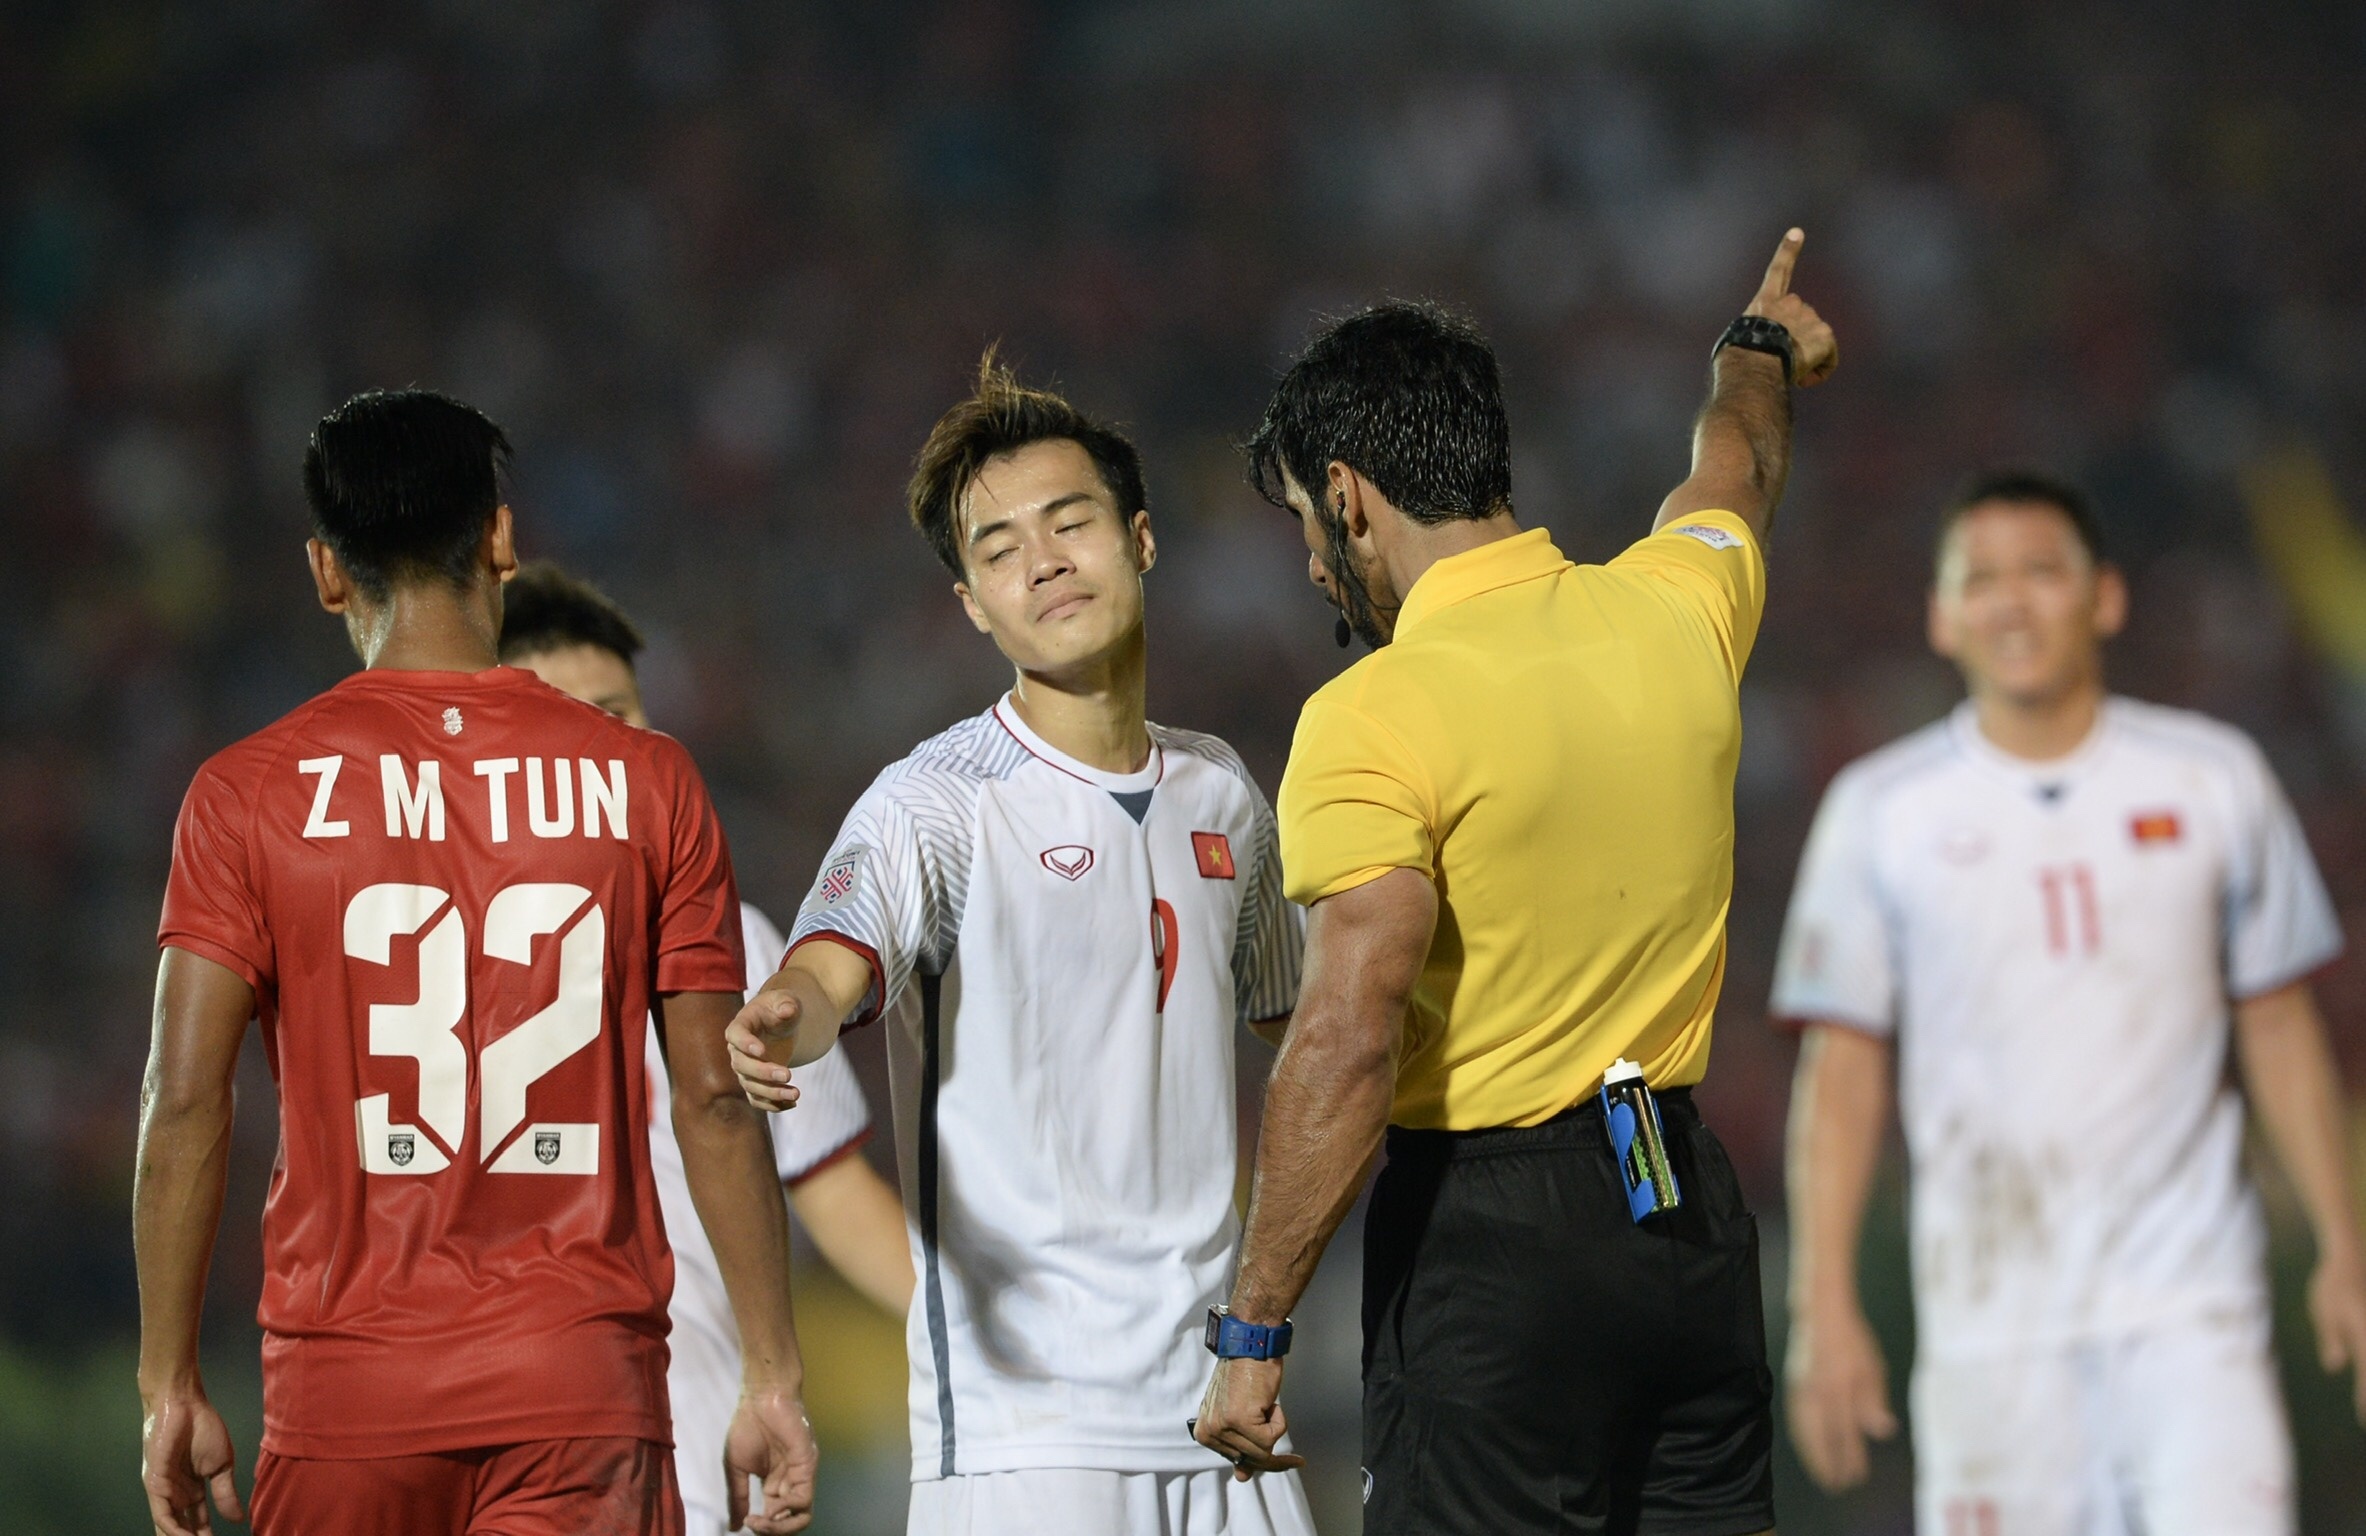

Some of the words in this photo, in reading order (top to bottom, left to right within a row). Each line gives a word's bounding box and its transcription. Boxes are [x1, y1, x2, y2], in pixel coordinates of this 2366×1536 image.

[298, 753, 350, 838] Z
[379, 753, 446, 842] M
[473, 756, 630, 843] TUN
[1150, 898, 1179, 1013] 9
[2038, 863, 2102, 957] 11
[343, 883, 605, 1175] 32
